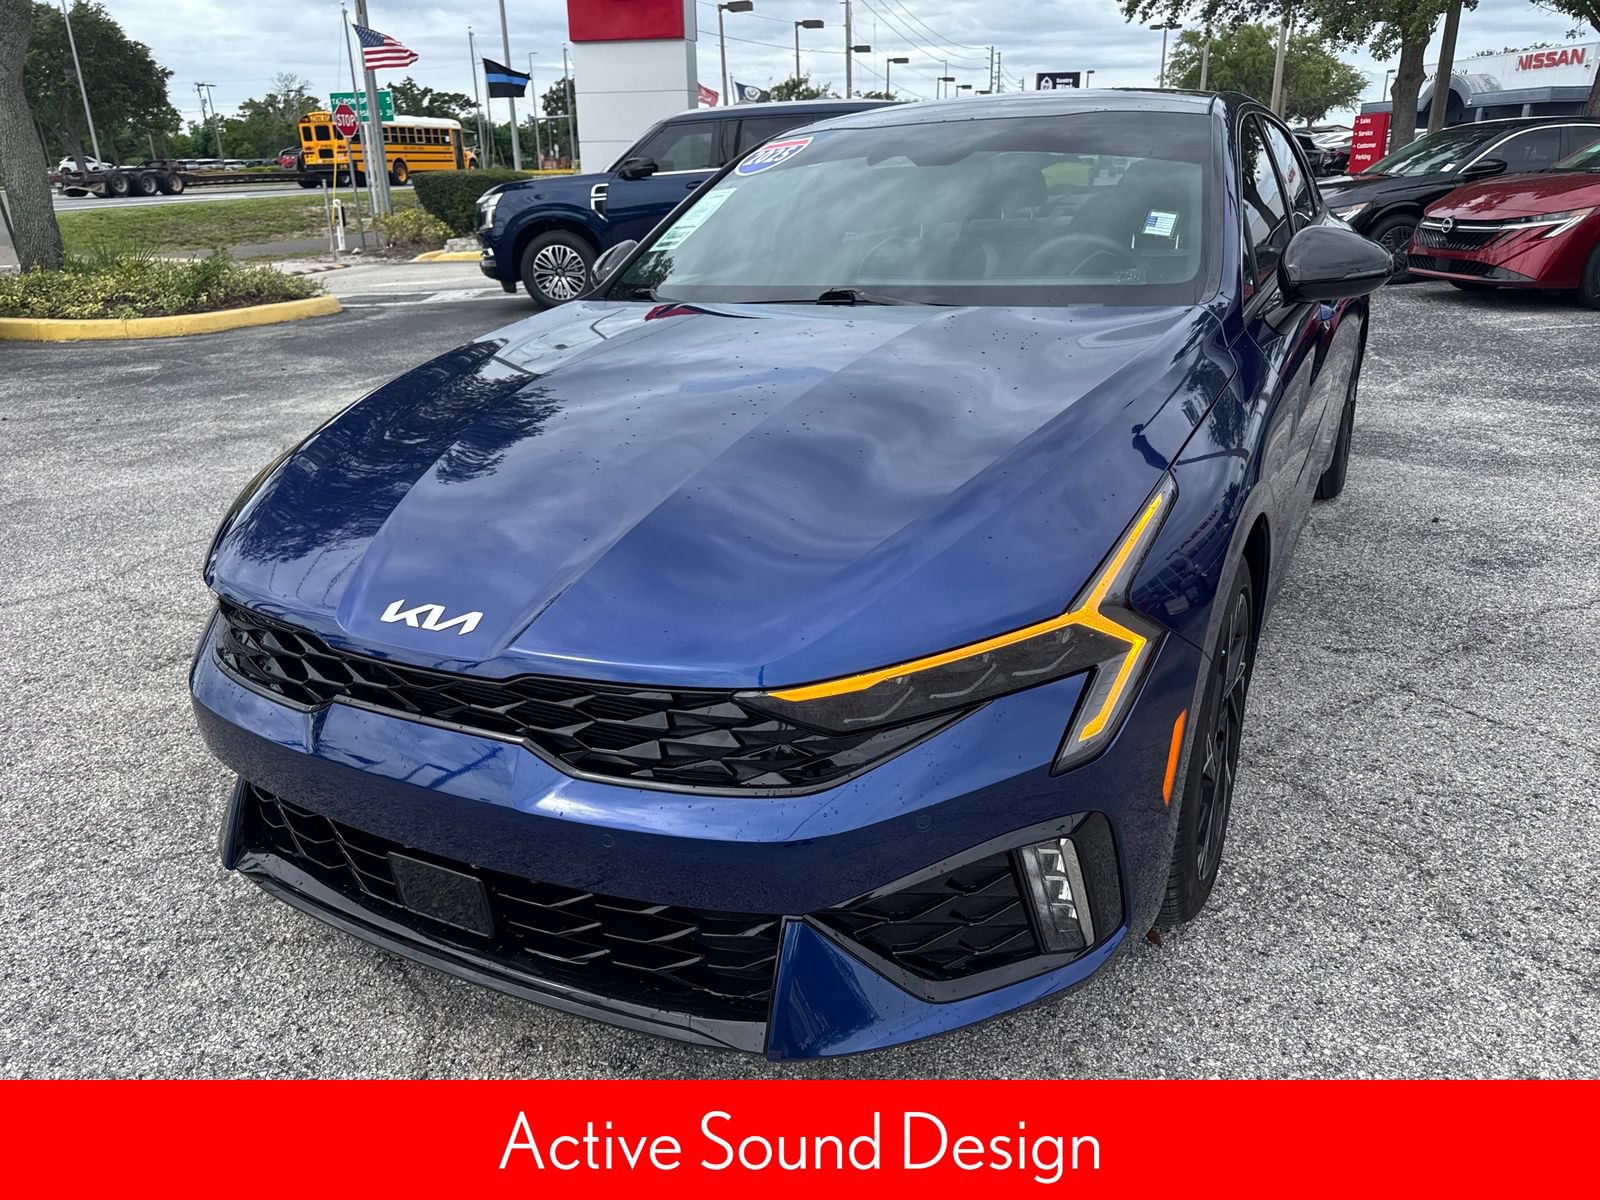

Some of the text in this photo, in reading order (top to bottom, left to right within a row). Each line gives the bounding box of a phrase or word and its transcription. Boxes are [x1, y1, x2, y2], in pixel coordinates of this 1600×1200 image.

[1515, 48, 1586, 72] NISSAN
[336, 114, 355, 127] STOP
[741, 145, 799, 167] 2025
